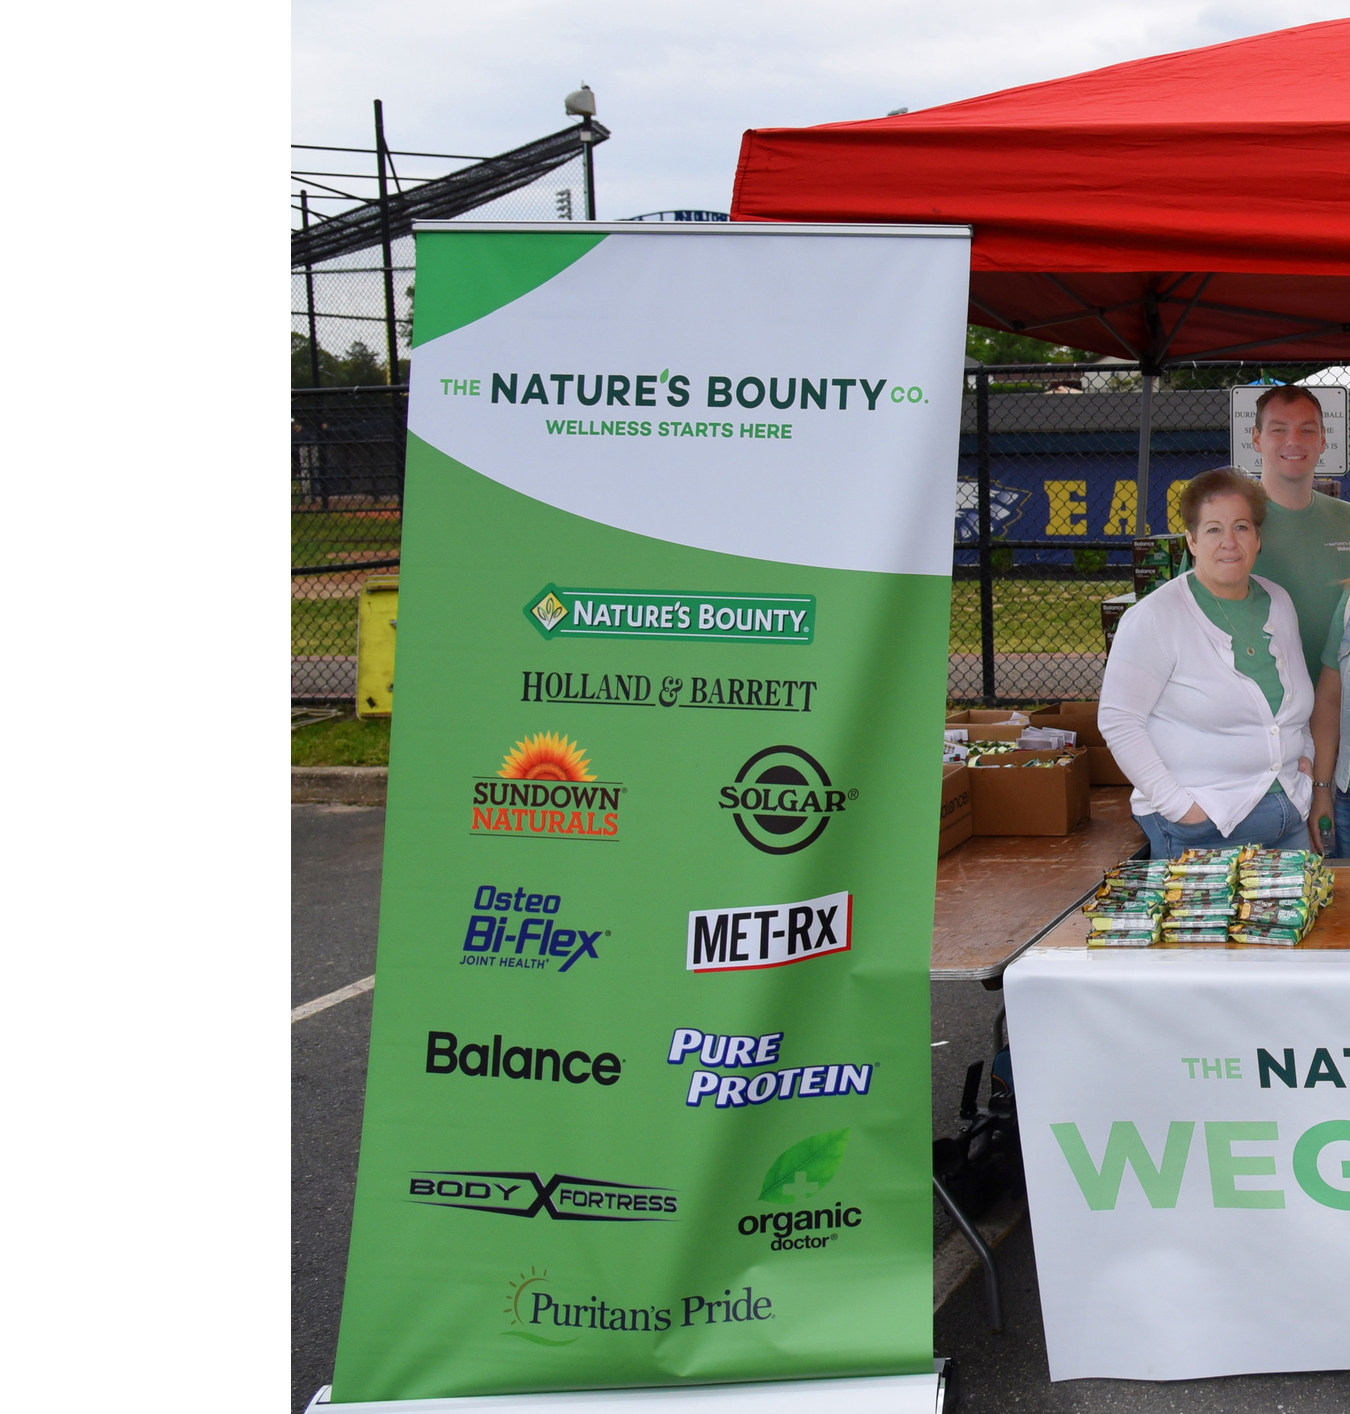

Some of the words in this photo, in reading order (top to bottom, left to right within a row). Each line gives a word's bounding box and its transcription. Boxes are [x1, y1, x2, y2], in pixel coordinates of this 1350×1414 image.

[440, 379, 481, 396] THE
[491, 368, 690, 407] NATURE'S
[707, 376, 887, 411] BOUNTY
[890, 386, 929, 404] CO.
[546, 420, 651, 436] WELLNESS
[658, 422, 733, 438] STARTS
[740, 423, 792, 439] HERE
[573, 601, 691, 628] NATURE'S
[521, 671, 651, 702] HOLLAND
[658, 676, 683, 707] &
[690, 677, 818, 711] BARRETT
[473, 782, 620, 810] SUNDOWN
[718, 786, 847, 813] SOLGAR
[941, 791, 969, 818] alance
[472, 807, 618, 836] NATURALS
[474, 885, 561, 914] Osteo
[463, 915, 604, 972] Bi-Flex
[460, 955, 496, 966] JOINT
[500, 957, 545, 969] HEALTH
[425, 1030, 622, 1086] Balance
[667, 1027, 785, 1069] PURE
[1181, 1057, 1243, 1079] THE
[686, 1062, 874, 1109] PROTEIN
[409, 1178, 523, 1202] BODY
[558, 1188, 679, 1213] FORTRESS
[737, 1201, 862, 1238] organic
[770, 1234, 831, 1251] doctor
[529, 1292, 672, 1332] Puritan's
[680, 1287, 773, 1328] Pride
